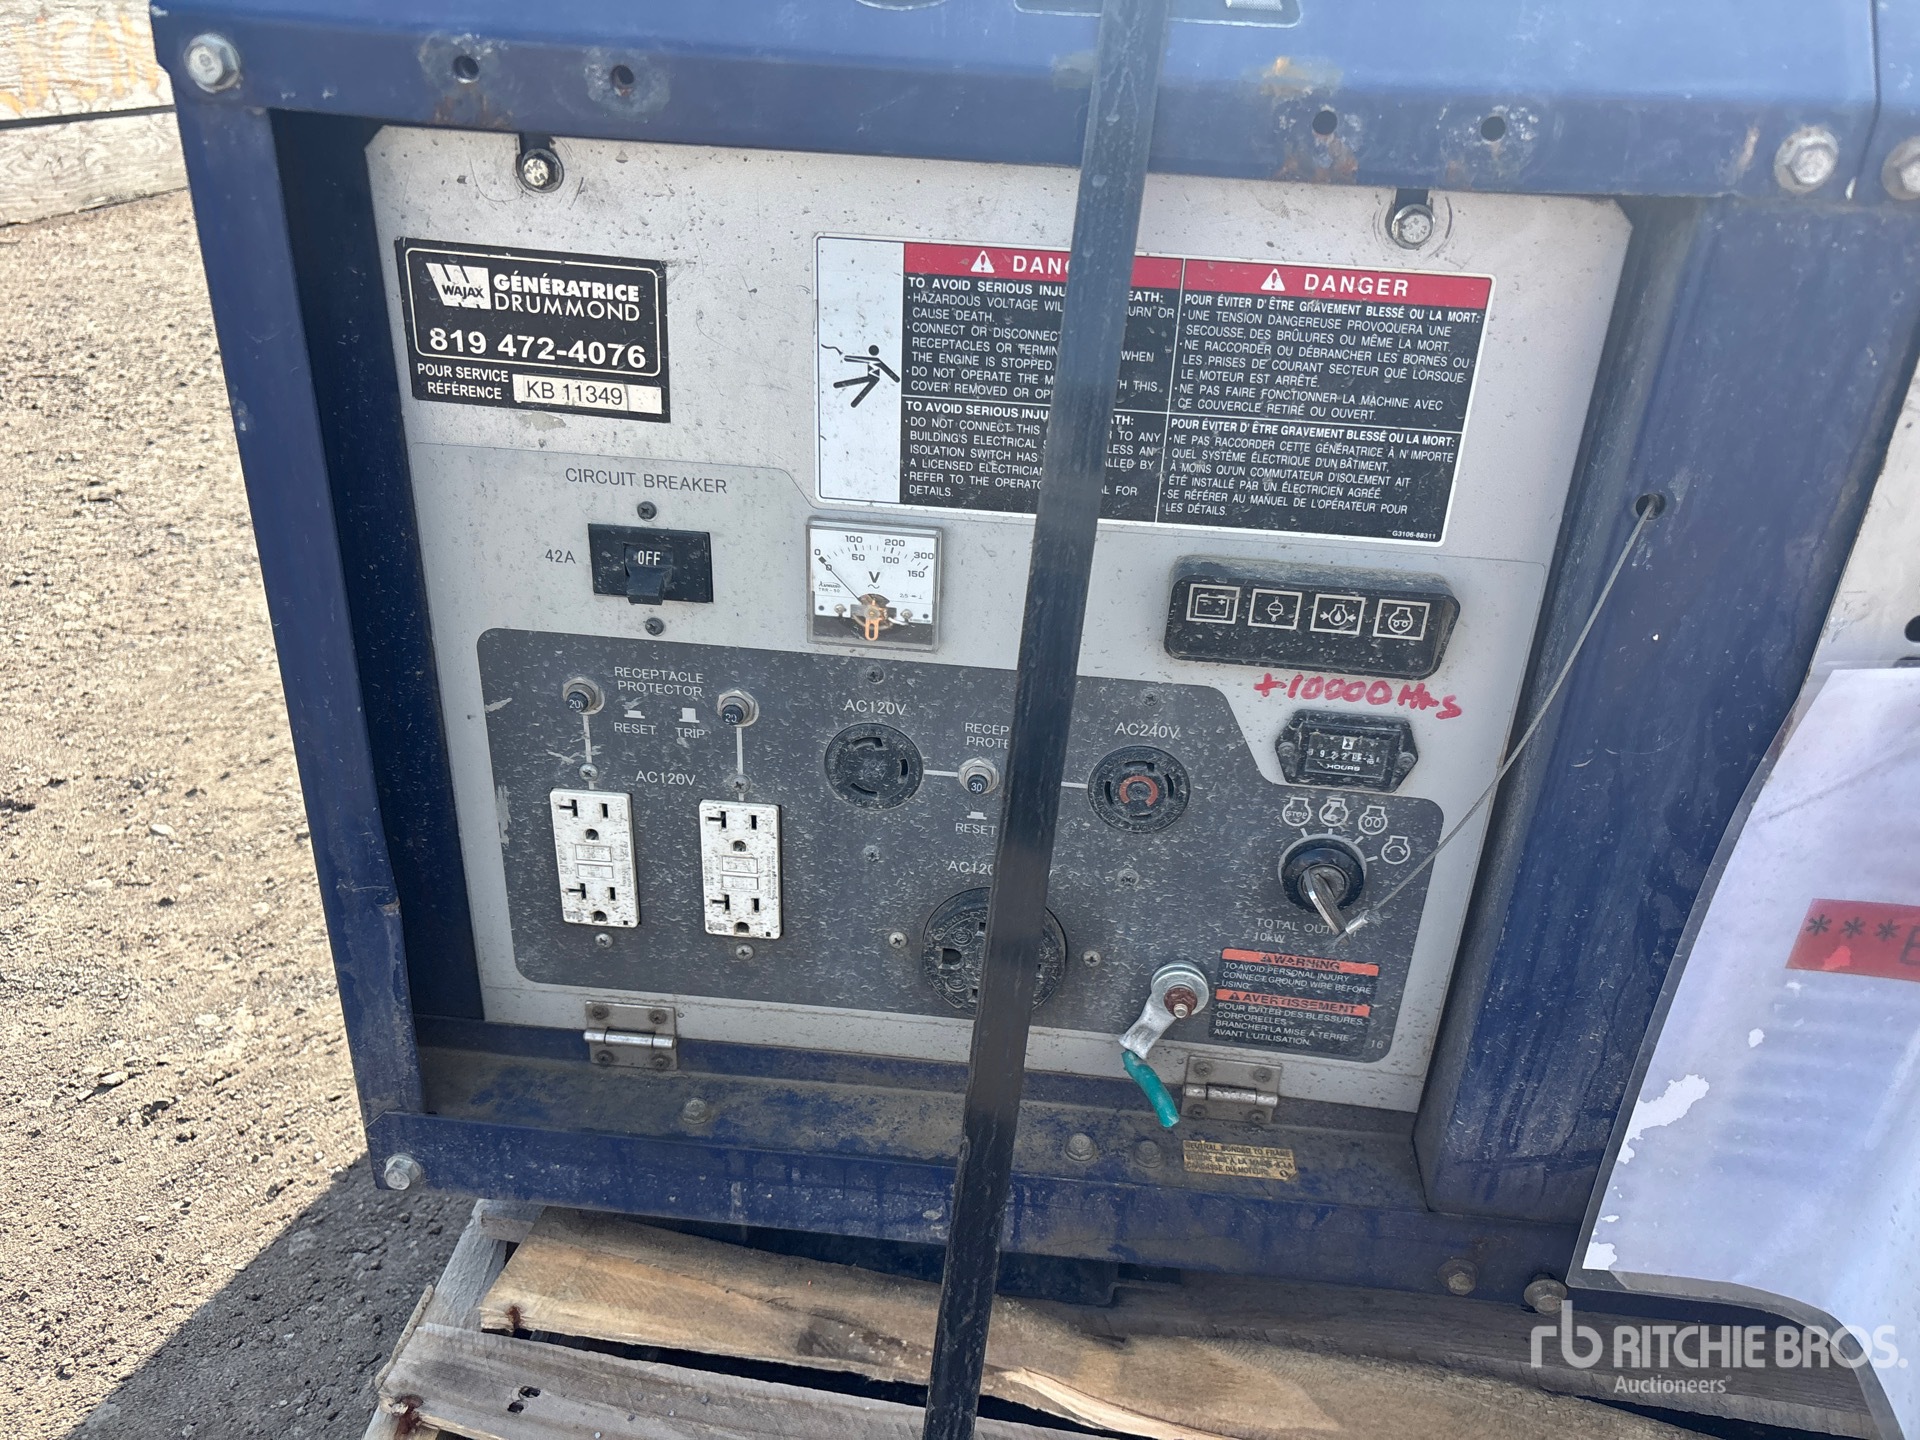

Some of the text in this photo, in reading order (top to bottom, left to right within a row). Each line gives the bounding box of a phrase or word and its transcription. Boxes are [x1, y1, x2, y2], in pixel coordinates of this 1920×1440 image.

[1012, 255, 1069, 275] DAN
[442, 284, 484, 298] WAJAX
[493, 270, 639, 302] GÉNÉRATRICE
[908, 277, 1164, 304] TO AVOID SERIOUS INJU EATH:
[1304, 273, 1409, 297] DANGER
[494, 294, 640, 322] DRUMMOND
[912, 293, 1174, 319] HAZARDOUS VOLTAGE WIL OR
[1185, 294, 1212, 306] POUR
[1217, 293, 1251, 308] ÉVITER
[1268, 296, 1294, 311] ÊTRE
[1300, 302, 1361, 316] GRAVEMENT
[1366, 306, 1404, 318] BLESSÉ
[1409, 309, 1425, 320] OU
[1430, 311, 1442, 321] LA
[1448, 312, 1480, 324] MORT:
[912, 308, 995, 323] CAUSE DEATH.
[1188, 310, 1452, 337] UNE TENSION DANGEREUSE PROVOQUERA UNE
[912, 323, 966, 337] CONNECT
[971, 327, 987, 338] OR
[1186, 325, 1450, 352] SECOUSSE, DES BRÛLURES OU MÊME LA MORT.
[430, 328, 646, 368] 819 472-4076
[912, 337, 991, 352] RECEPTACLES
[997, 342, 1013, 354] OR
[912, 352, 1054, 371] THE ENGINE IS STOPPED.
[417, 364, 509, 382] POUR SERVICE
[911, 366, 1158, 392] DO NOT OPERATE THE THIS
[427, 381, 502, 400] RÉFÉRENCE
[526, 380, 623, 406] KB 11349
[911, 380, 1029, 398] COVER REMOVED OR
[906, 401, 1048, 420] TO AVOID SERIOUS INJU
[910, 417, 1162, 442] DO NOT CONNECT THIS TO ANY
[1171, 419, 1199, 430] POUR
[1202, 418, 1238, 432] ÉVITER
[1252, 421, 1278, 435] ÊTRE
[1281, 426, 1344, 439] GRAVEMENT
[1347, 430, 1386, 441] BLESSÉ
[1389, 432, 1404, 442] OU
[1406, 433, 1419, 443] LA
[1421, 434, 1455, 446] MORT:
[910, 431, 1154, 455] BUILDING'S ELECTRICAL AN
[910, 444, 1154, 469] ISOLATION SWITCH HAS BY
[909, 459, 973, 472] A LICENSED
[566, 468, 727, 493] CIRCUIT BREAKER
[909, 471, 1138, 495] REFER TO THE FOR
[909, 485, 953, 498] DETAILS.
[845, 535, 862, 543] 100
[545, 549, 576, 564] 42A
[638, 551, 660, 565] OFF
[882, 556, 899, 564] 100
[869, 571, 880, 583] V
[908, 570, 924, 578] 150
[614, 667, 704, 683] RECEPTACLE
[618, 681, 702, 696] PROTECTOR
[1254, 673, 1392, 705] +10000
[843, 699, 906, 715] AC120V
[614, 723, 705, 738] RESET TRIP
[965, 723, 1009, 735] RECEP
[1114, 722, 1180, 739] AC240V
[635, 771, 696, 786] AC120V
[971, 782, 982, 792] 30
[1286, 810, 1308, 818] STOP
[955, 823, 997, 835] RESET
[1256, 918, 1300, 931] TOTAL
[1274, 955, 1340, 971] WARNING
[1238, 964, 1264, 972] AVOID
[1267, 967, 1315, 979] PERSONAL
[1318, 972, 1349, 982] INJURY
[1222, 981, 1249, 989] USING
[1223, 972, 1371, 994] CONNECT GROUND WIRE BEFORE
[1218, 1003, 1245, 1011] POUR
[1285, 1010, 1303, 1018] DES
[1244, 993, 1356, 1013] AVERTISSEMENT
[1214, 1029, 1243, 1037] AVANT
[1216, 1021, 1267, 1031] BRANCHER
[1284, 1027, 1306, 1036] MISE
[1318, 1032, 1349, 1041] TERRE
[1370, 1040, 1384, 1048] 16
